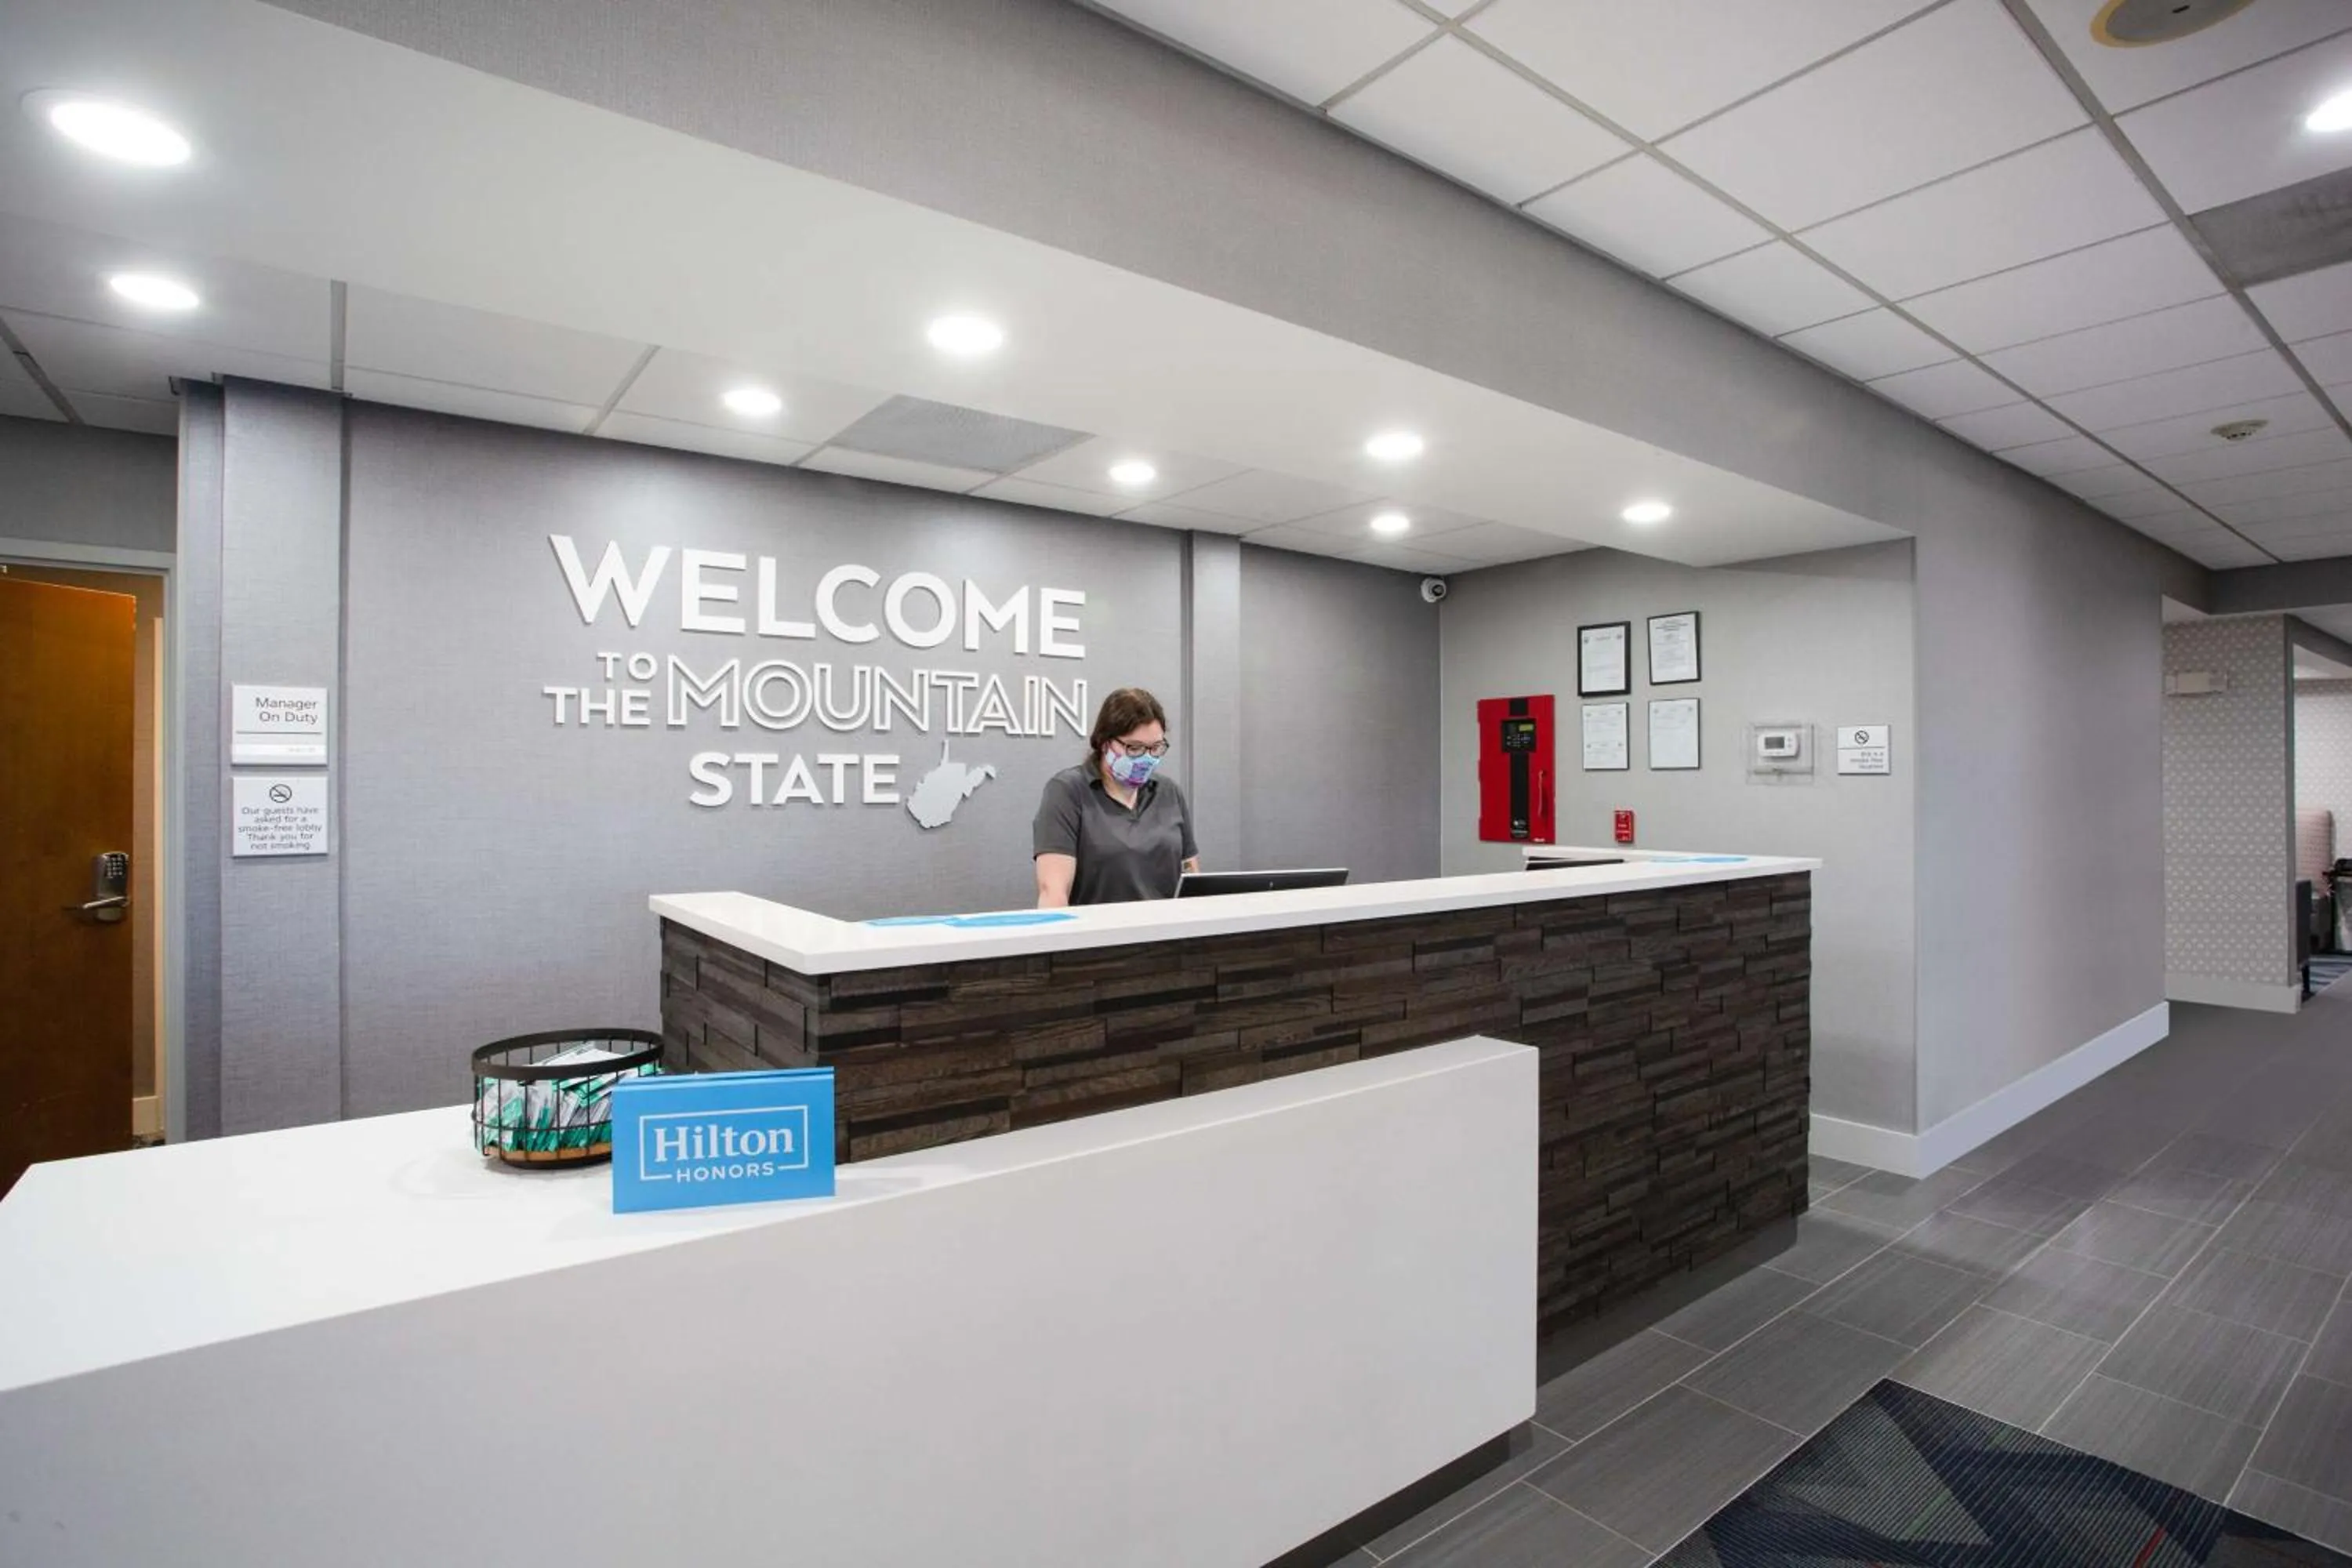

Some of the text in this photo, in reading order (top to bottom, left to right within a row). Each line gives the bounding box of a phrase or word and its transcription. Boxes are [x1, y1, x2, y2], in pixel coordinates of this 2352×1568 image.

[549, 534, 1086, 658] WELCOME
[597, 652, 658, 681] TO
[256, 697, 318, 710] Manager
[544, 655, 1087, 737] THE MOUNTAIN
[260, 711, 318, 724] On Duty
[689, 752, 900, 807] STATE
[263, 808, 294, 816] guests
[248, 833, 276, 841] Thank
[281, 833, 297, 842] you
[654, 1125, 795, 1163] Hilton
[677, 1163, 775, 1183] HONORS
